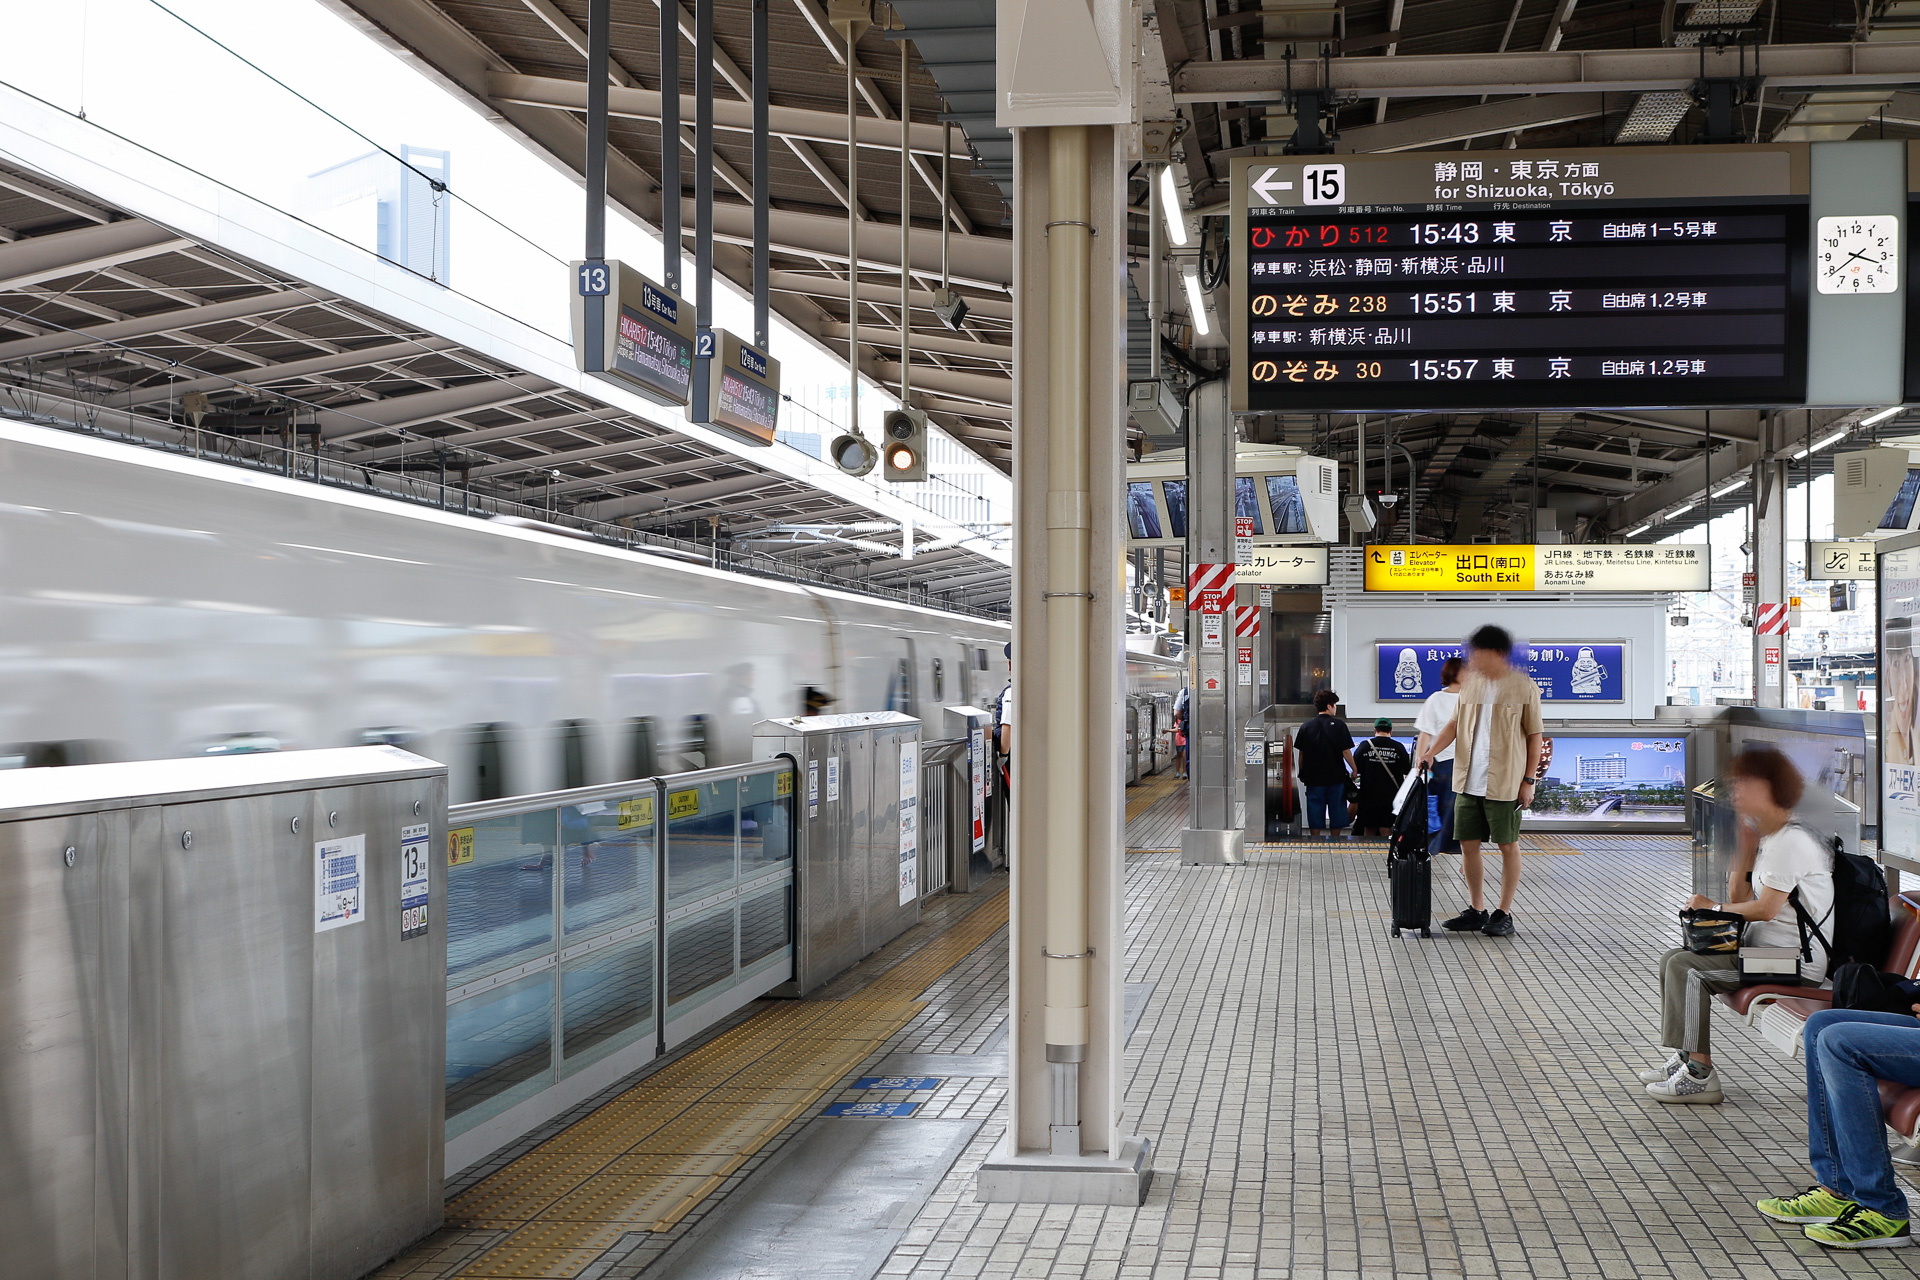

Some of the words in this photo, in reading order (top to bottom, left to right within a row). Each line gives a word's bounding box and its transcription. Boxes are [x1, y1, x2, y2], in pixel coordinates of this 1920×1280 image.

[1307, 169, 1340, 200] 15
[1434, 185, 1460, 199] for
[1465, 183, 1553, 199] Shizuoka,
[1558, 181, 1615, 198] Tōkyō
[1338, 206, 1372, 214] 列車番号
[1426, 204, 1443, 212] 時刻
[1493, 202, 1510, 210] 行先
[1251, 208, 1276, 216] 列車名
[1838, 229, 1846, 238] 11
[1851, 225, 1862, 234] 12
[1868, 229, 1872, 237] 1
[1251, 224, 1340, 248] ひかり
[1349, 226, 1388, 244] 512
[1409, 222, 1479, 245] 15:43
[1828, 238, 1838, 248] 10
[1878, 238, 1884, 246] 2
[1825, 252, 1832, 262] 9
[1881, 252, 1887, 260] 3
[1829, 266, 1835, 274] 8
[1877, 265, 1882, 273] 4
[581, 267, 606, 292] 13
[1839, 276, 1846, 284] 7
[1853, 278, 1860, 288] 6
[1867, 274, 1873, 284] 5
[644, 285, 662, 312] 13号車
[1251, 294, 1339, 317] のぞみ
[1348, 296, 1387, 313] 238
[1409, 292, 1477, 314] 15:51
[647, 329, 662, 354] 15:43
[1309, 327, 1411, 346] 新横浜・品川
[695, 335, 712, 356] 12
[1251, 360, 1339, 382] のぞみ
[1356, 361, 1382, 379] 30
[1409, 359, 1478, 380] 15:57
[1410, 550, 1448, 559] エレベーター
[1456, 572, 1492, 582] South
[1497, 572, 1520, 582] Exit
[1544, 570, 1594, 579] あおなみ線
[404, 846, 418, 880] 13
